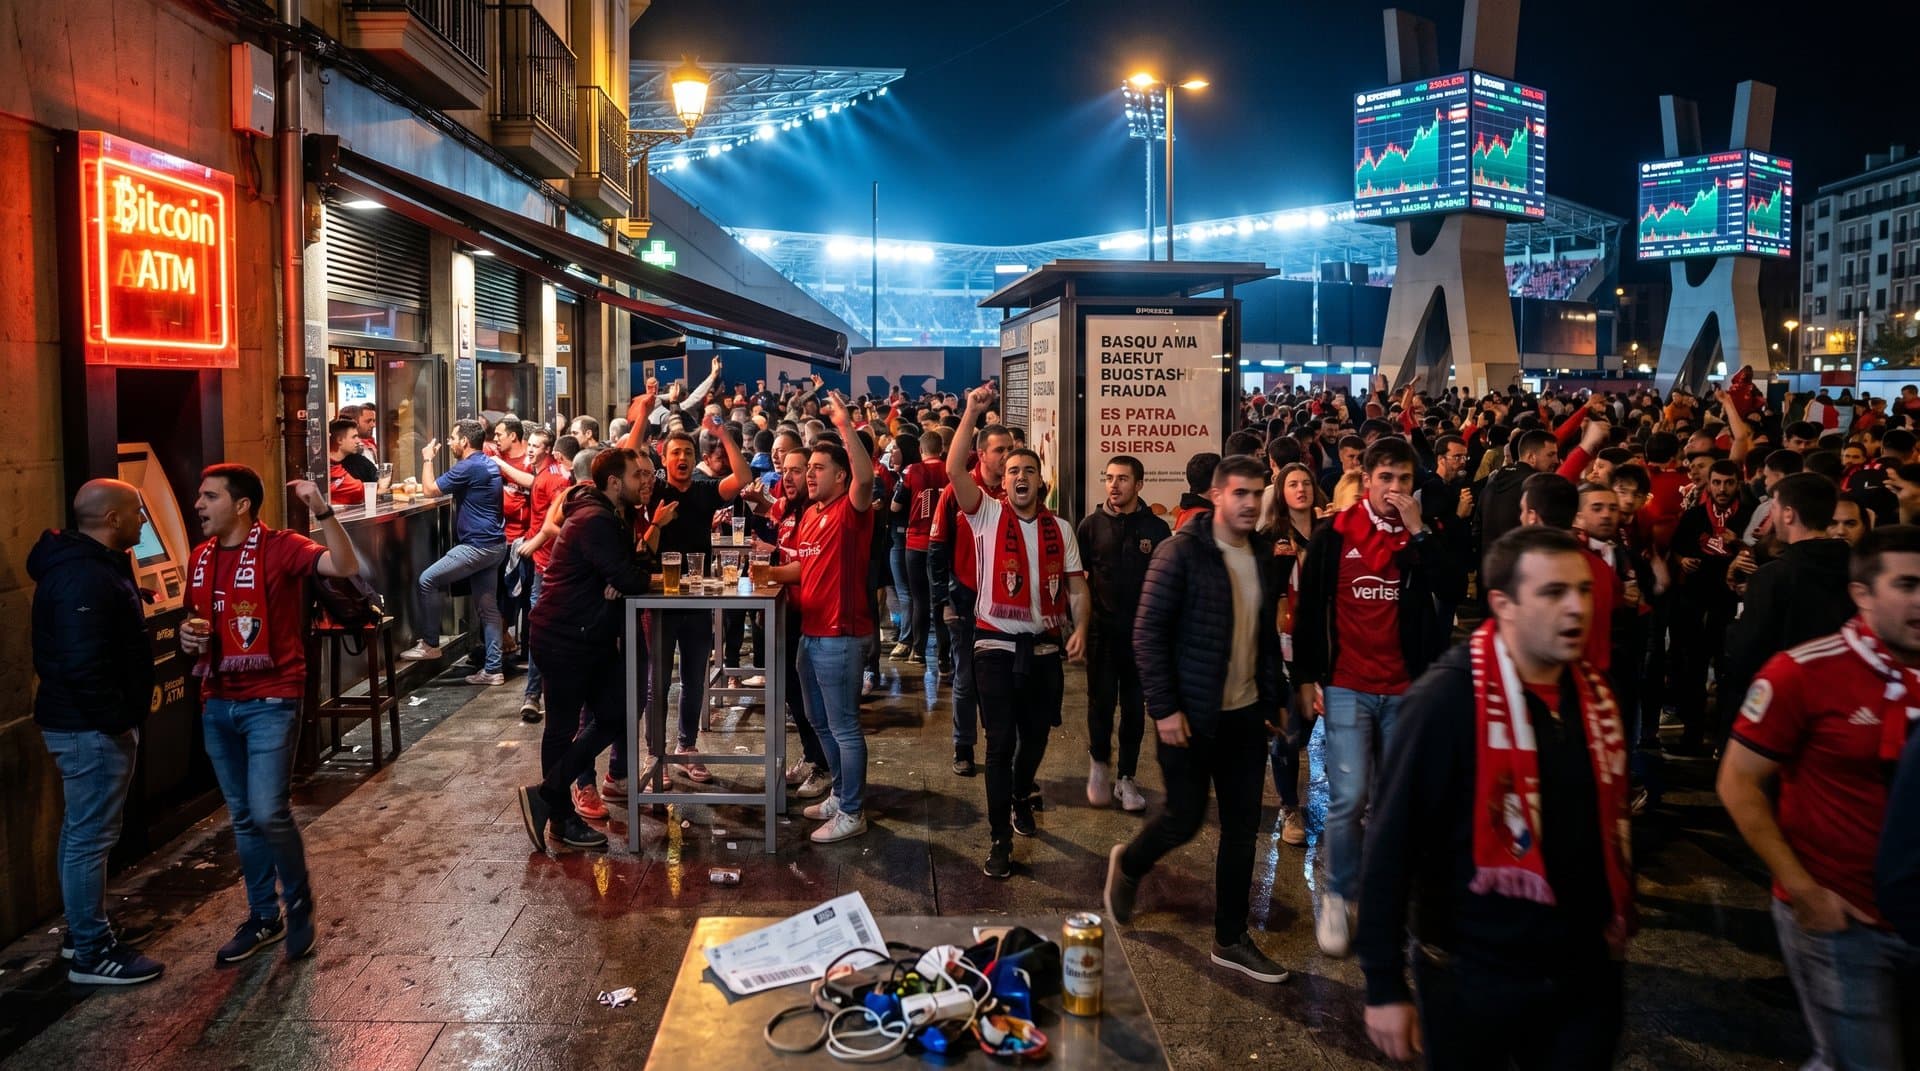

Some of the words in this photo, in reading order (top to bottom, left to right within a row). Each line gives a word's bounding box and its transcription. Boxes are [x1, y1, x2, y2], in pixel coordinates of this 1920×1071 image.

[112, 174, 216, 247] Bitcoin
[1101, 335, 1157, 349] BASQU
[1101, 384, 1167, 397] FRAUDA
[1101, 408, 1121, 421] ES
[1126, 408, 1176, 421] PATRA
[1100, 424, 1122, 437] UA
[1127, 424, 1209, 437] FRAUDICA
[1100, 440, 1176, 453] SISIERSA
